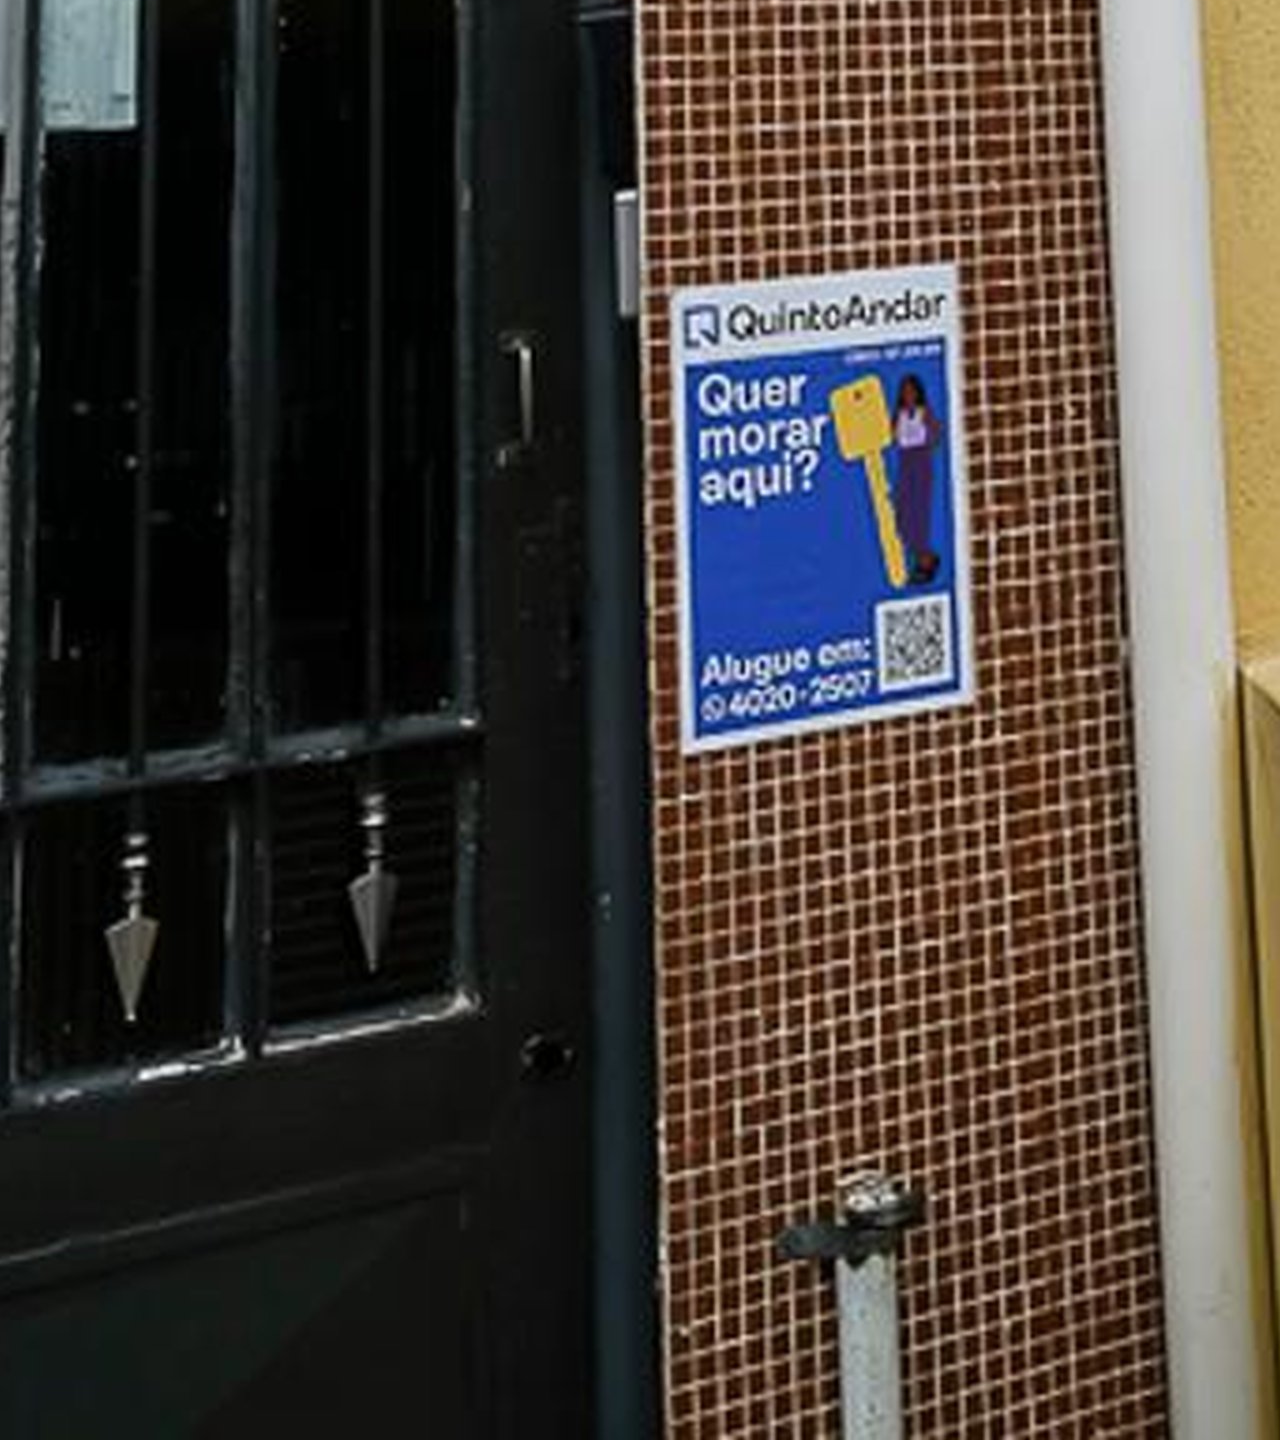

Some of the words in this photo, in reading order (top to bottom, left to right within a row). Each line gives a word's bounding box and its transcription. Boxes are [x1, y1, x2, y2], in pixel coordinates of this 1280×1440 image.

[726, 289, 947, 342] QuintoAndar
[697, 372, 808, 417] Quer
[698, 413, 830, 460] morar
[698, 449, 820, 508] aqui?
[699, 646, 811, 687] Alugue
[817, 636, 871, 668] em:
